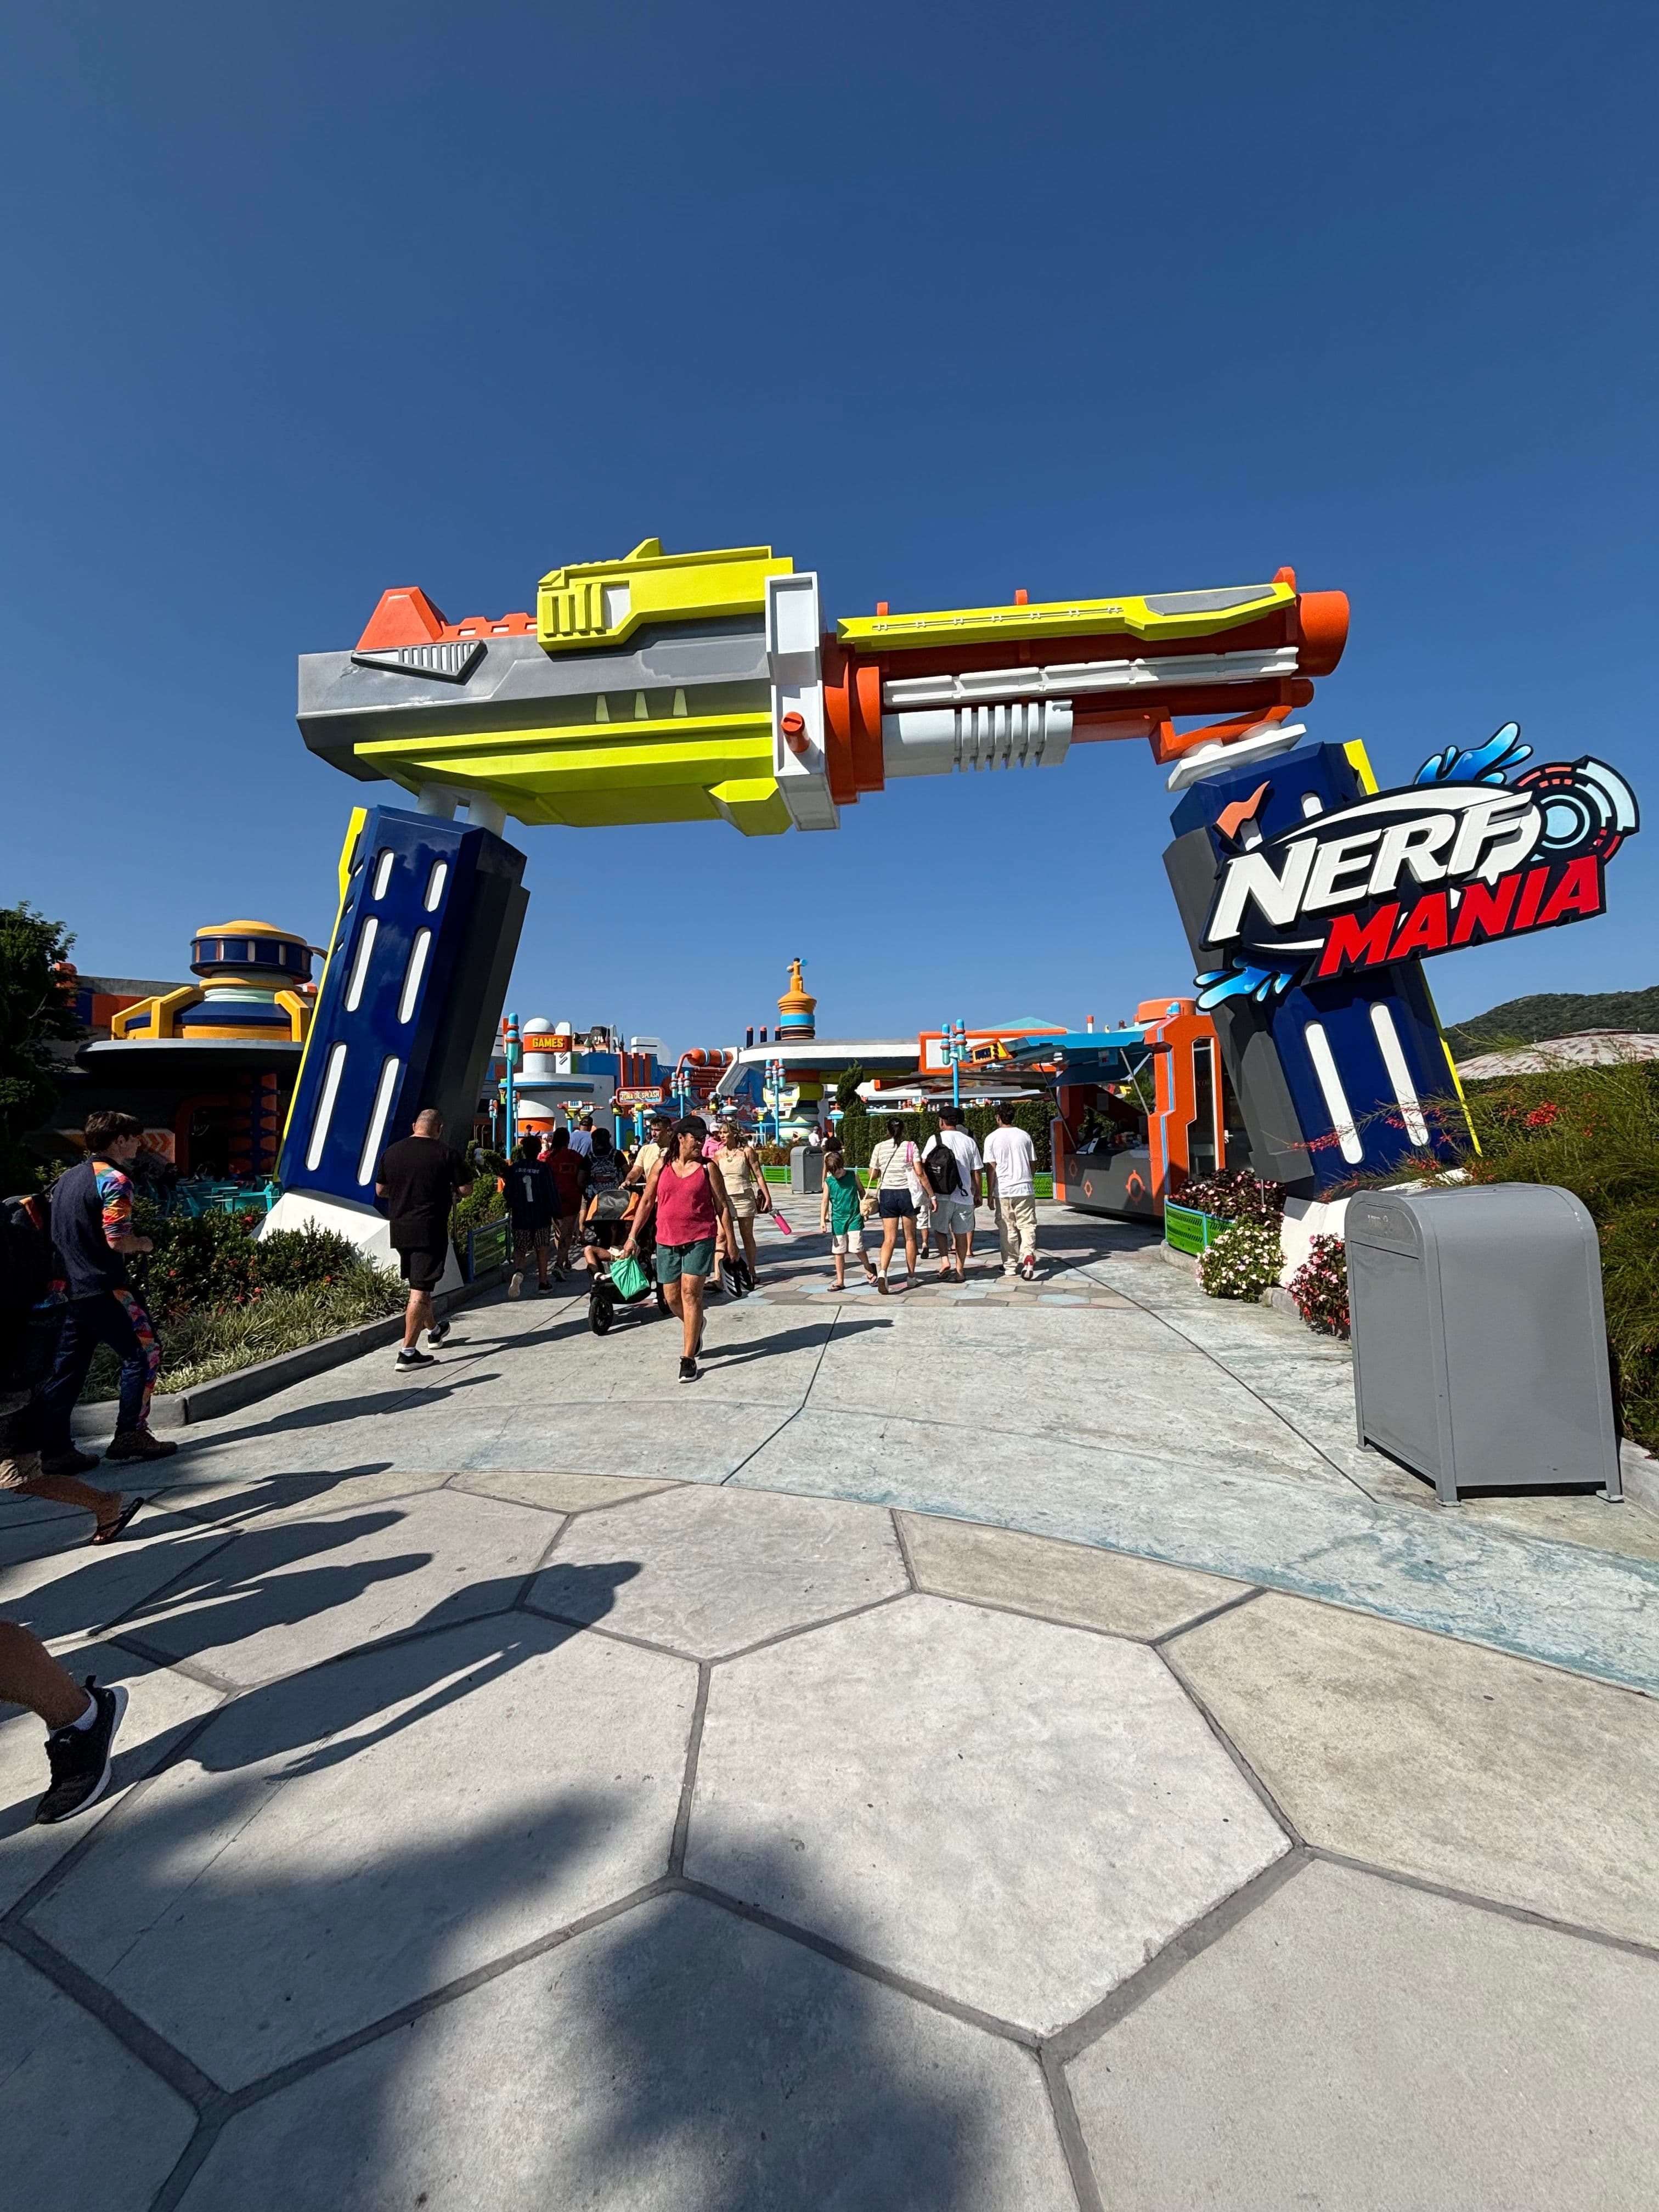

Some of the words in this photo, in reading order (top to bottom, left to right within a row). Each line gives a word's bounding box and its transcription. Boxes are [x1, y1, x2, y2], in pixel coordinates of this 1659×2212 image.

[1208, 791, 1533, 943] NERF
[1317, 854, 1600, 977] MANIA
[532, 1037, 563, 1048] GAMES
[641, 1091, 659, 1099] SPLASH
[522, 1175, 533, 1202] 1
